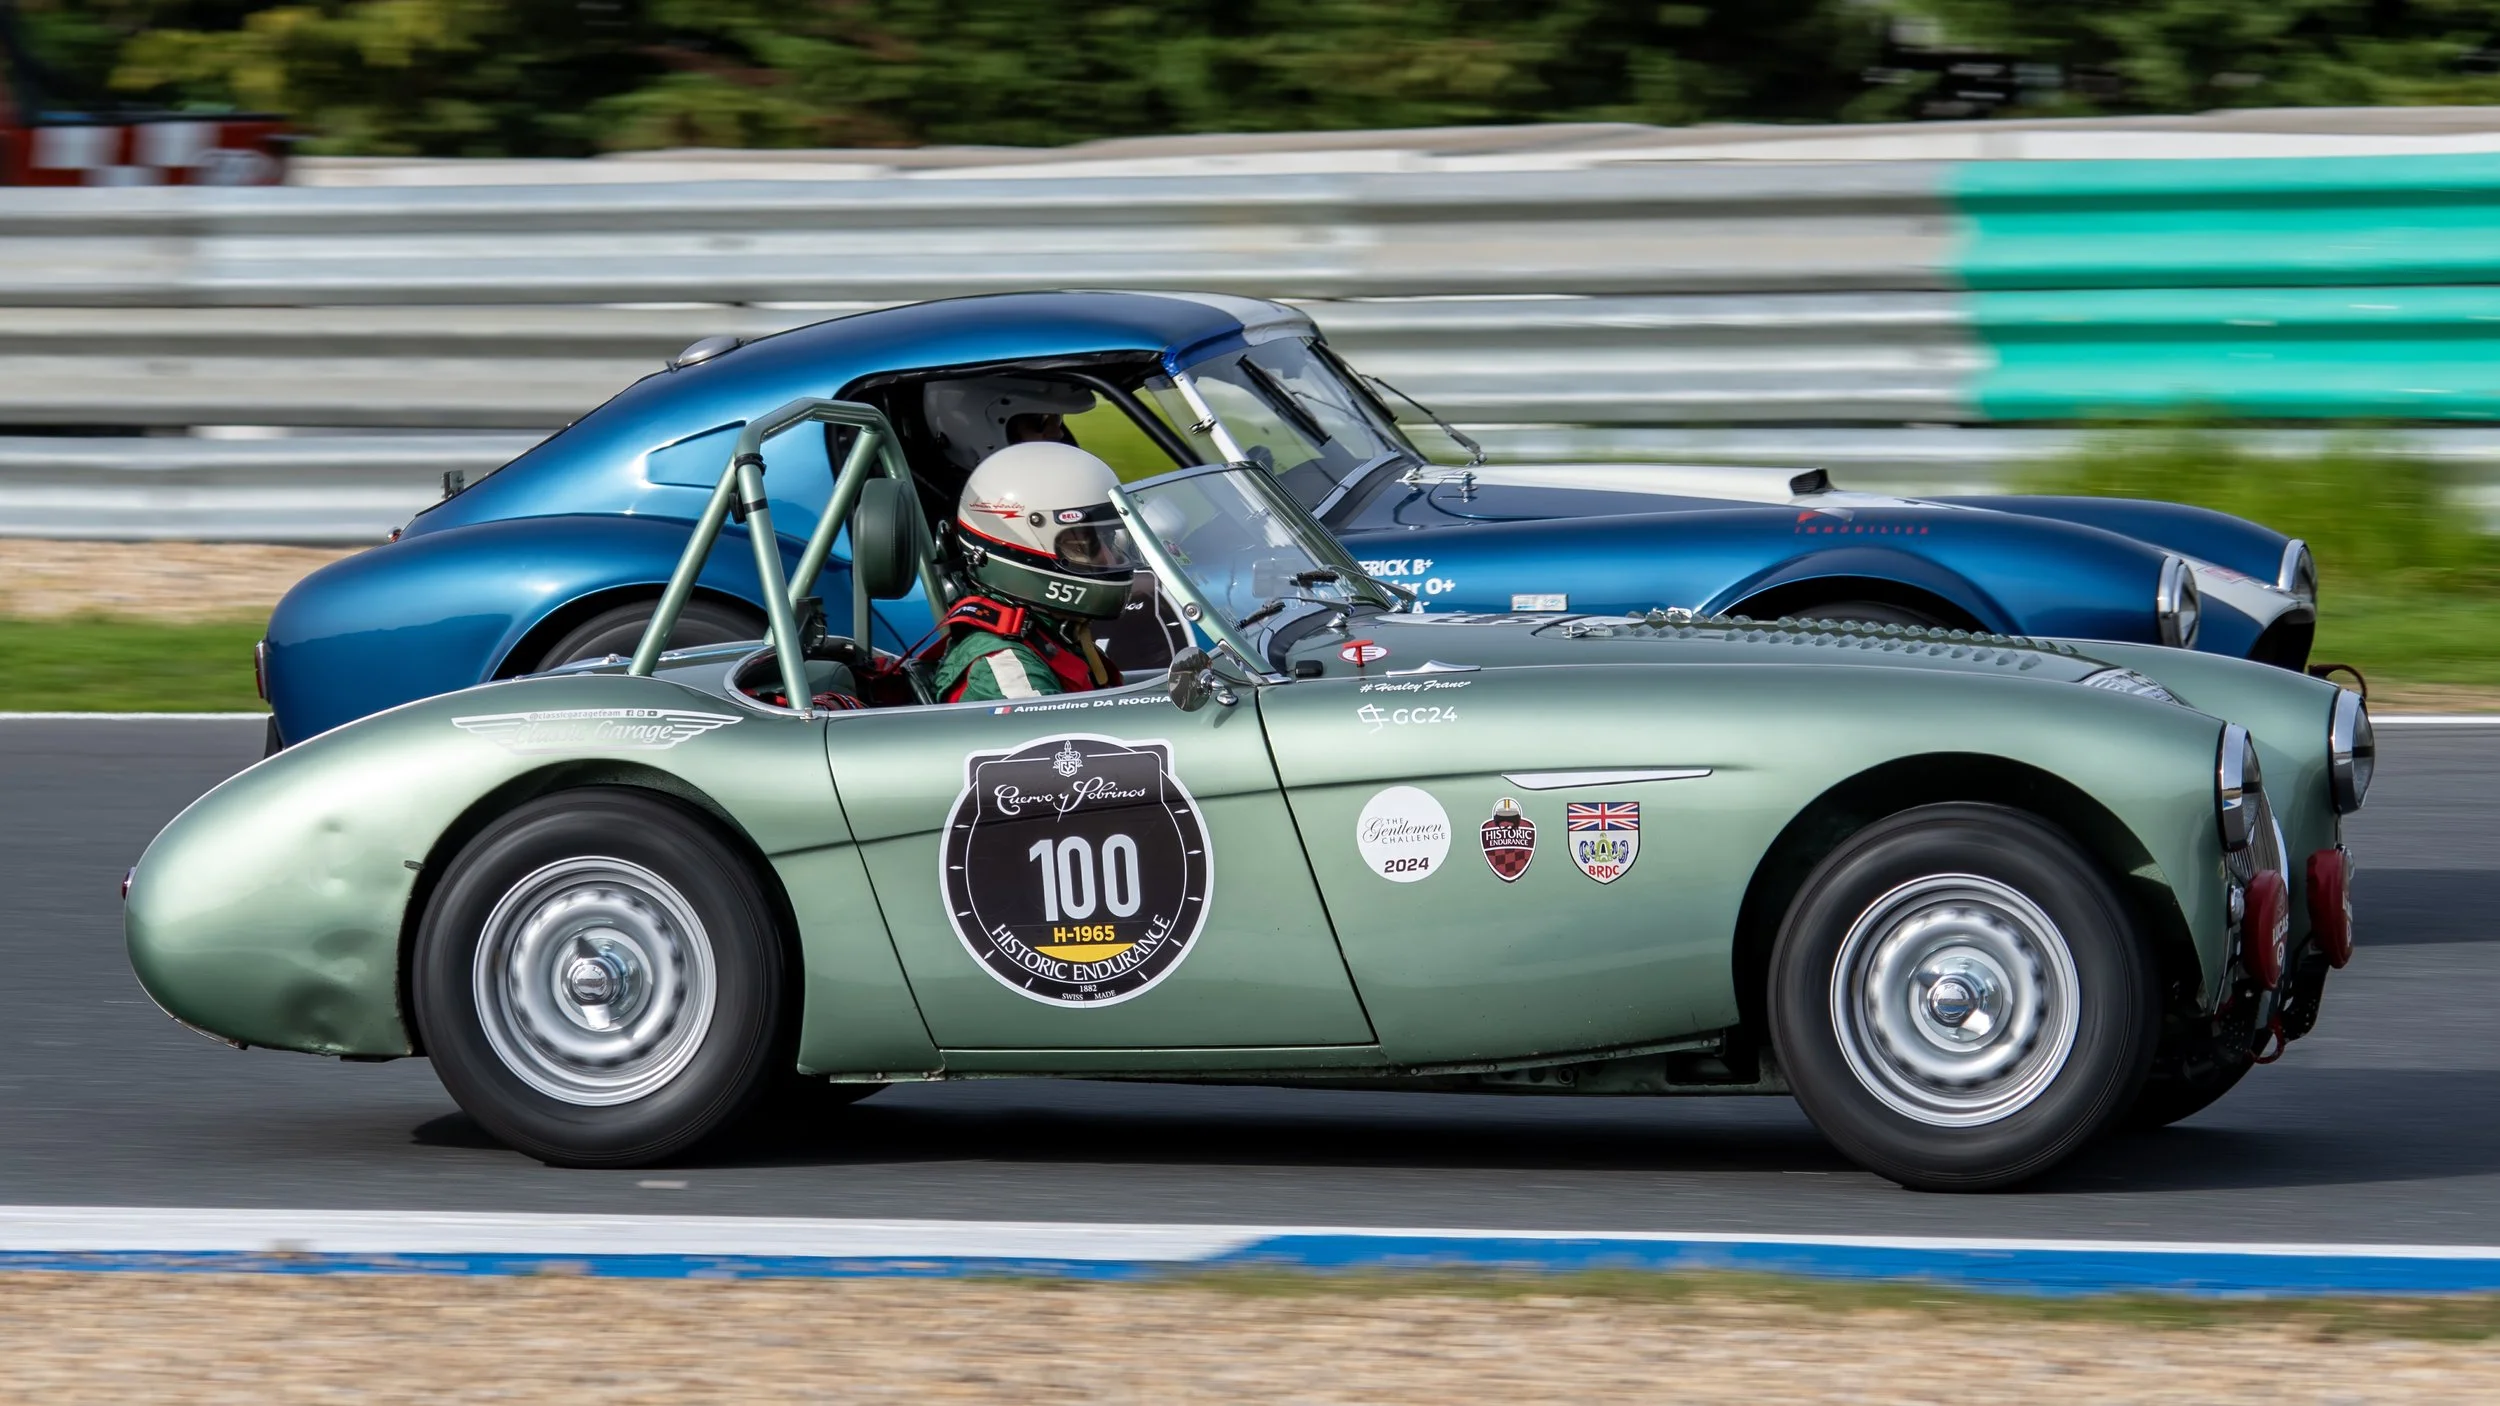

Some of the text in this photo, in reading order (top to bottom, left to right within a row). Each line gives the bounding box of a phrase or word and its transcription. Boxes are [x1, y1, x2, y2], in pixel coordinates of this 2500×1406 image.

[1412, 559, 1434, 575] B+
[1045, 581, 1087, 605] 557
[1425, 578, 1456, 595] O+
[1014, 702, 1089, 713] Amandine
[1118, 696, 1171, 705] ROCHA
[1392, 706, 1458, 725] GC24
[594, 720, 673, 743] Garage
[994, 784, 1053, 816] Cuervo
[1073, 776, 1146, 812] Sobrinos
[1362, 817, 1442, 843] Gentlemen
[1381, 832, 1446, 845] CHALLENGE
[1485, 829, 1532, 841] HISTORIC
[1384, 857, 1429, 873] 2024
[1588, 865, 1620, 879] BRDC
[1029, 833, 1141, 922] 100
[1053, 925, 1116, 943] H-1965
[991, 914, 1171, 981] HISTORIC ENDURANCE
[1079, 984, 1097, 993] 1882
[1094, 990, 1116, 1000] MADE
